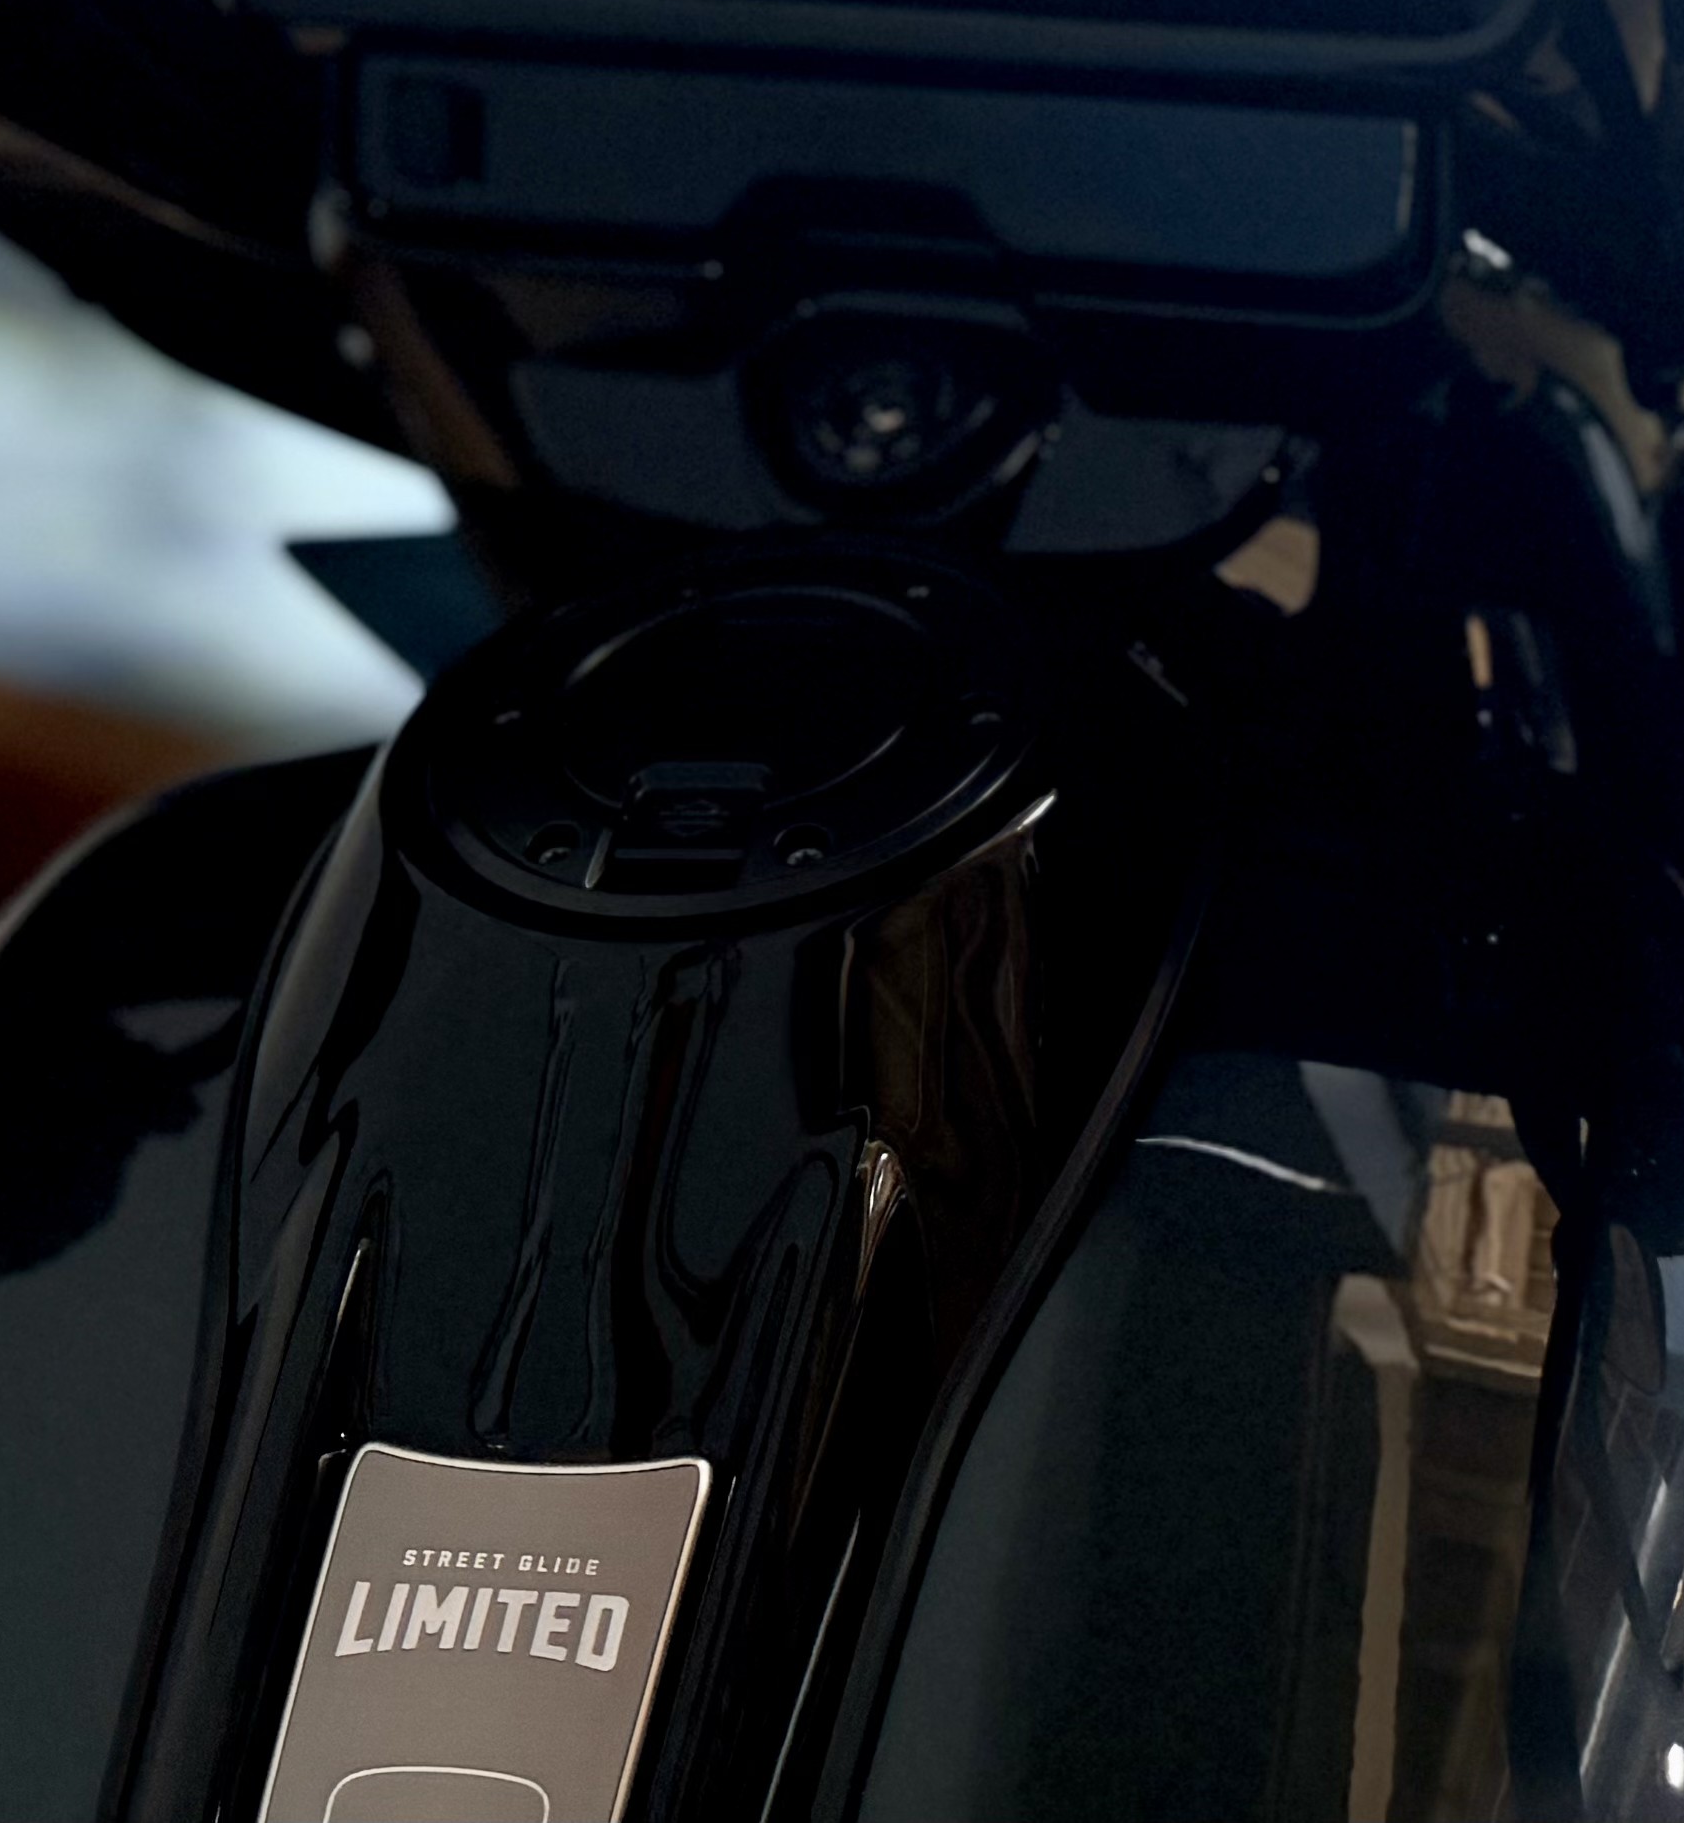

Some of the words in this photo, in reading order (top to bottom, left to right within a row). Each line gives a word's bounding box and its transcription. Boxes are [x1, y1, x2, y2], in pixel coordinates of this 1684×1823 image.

[402, 1548, 506, 1571] STREET
[518, 1553, 601, 1576] GLIDE
[335, 1580, 631, 1672] LIMITED
